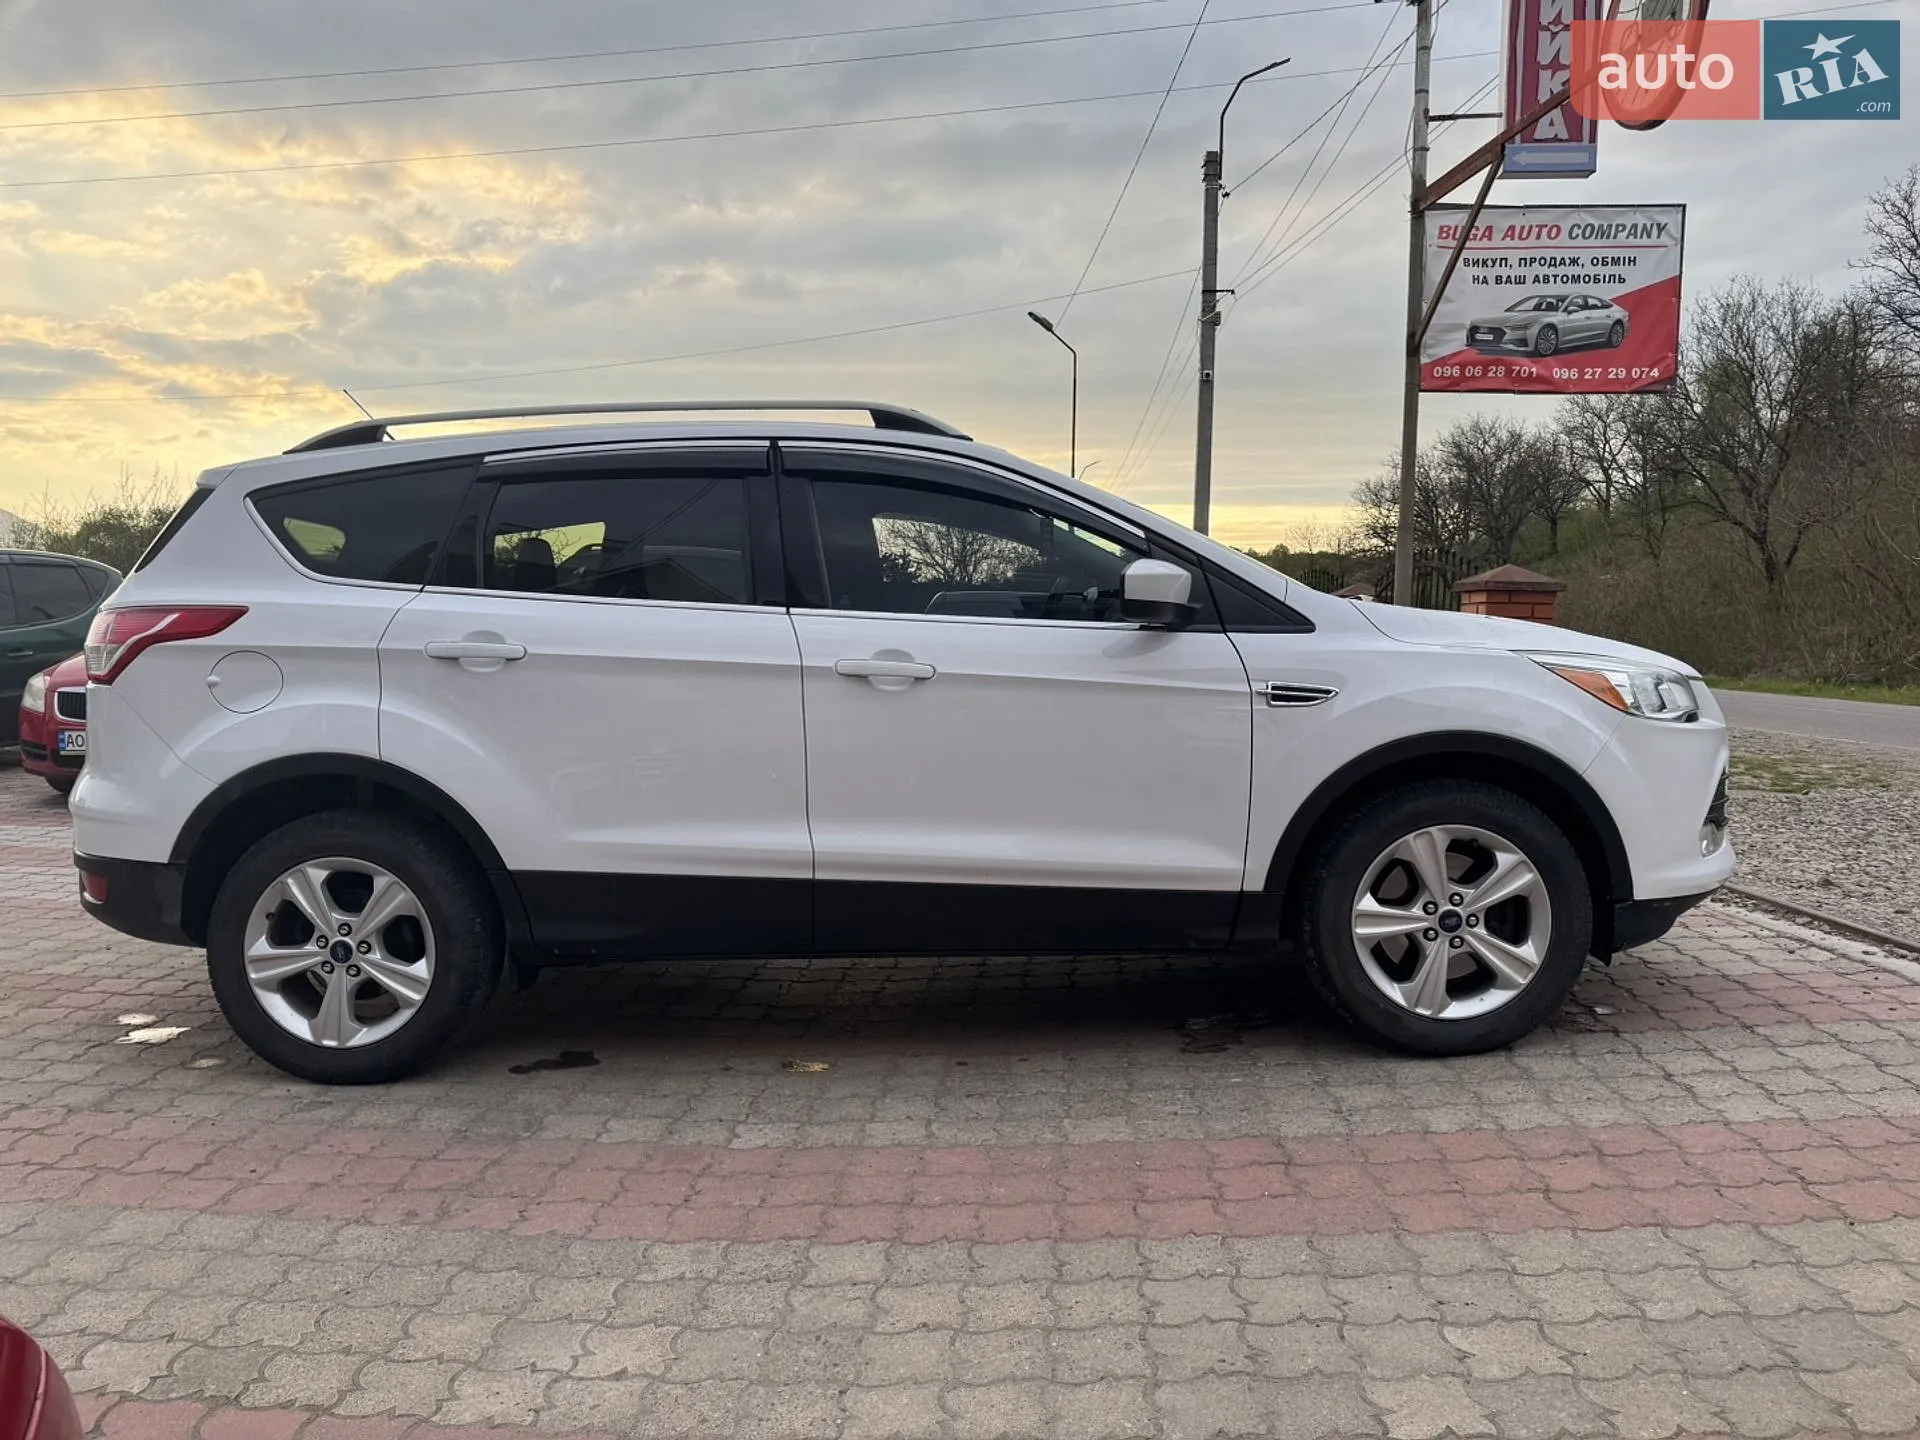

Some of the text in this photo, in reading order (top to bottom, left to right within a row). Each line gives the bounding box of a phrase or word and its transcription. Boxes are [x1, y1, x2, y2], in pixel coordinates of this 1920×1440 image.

[1501, 224, 1561, 241] AUTO
[1568, 222, 1668, 240] COMPANY
[1463, 256, 1637, 270] ВИКУП, ПРОДАЖ, ОБМІН
[1472, 273, 1626, 285] НА ВАШ АВТОМОБІЛЬ
[1433, 366, 1537, 378] 096 06 28 701
[1553, 367, 1659, 379] 096 27 29 074
